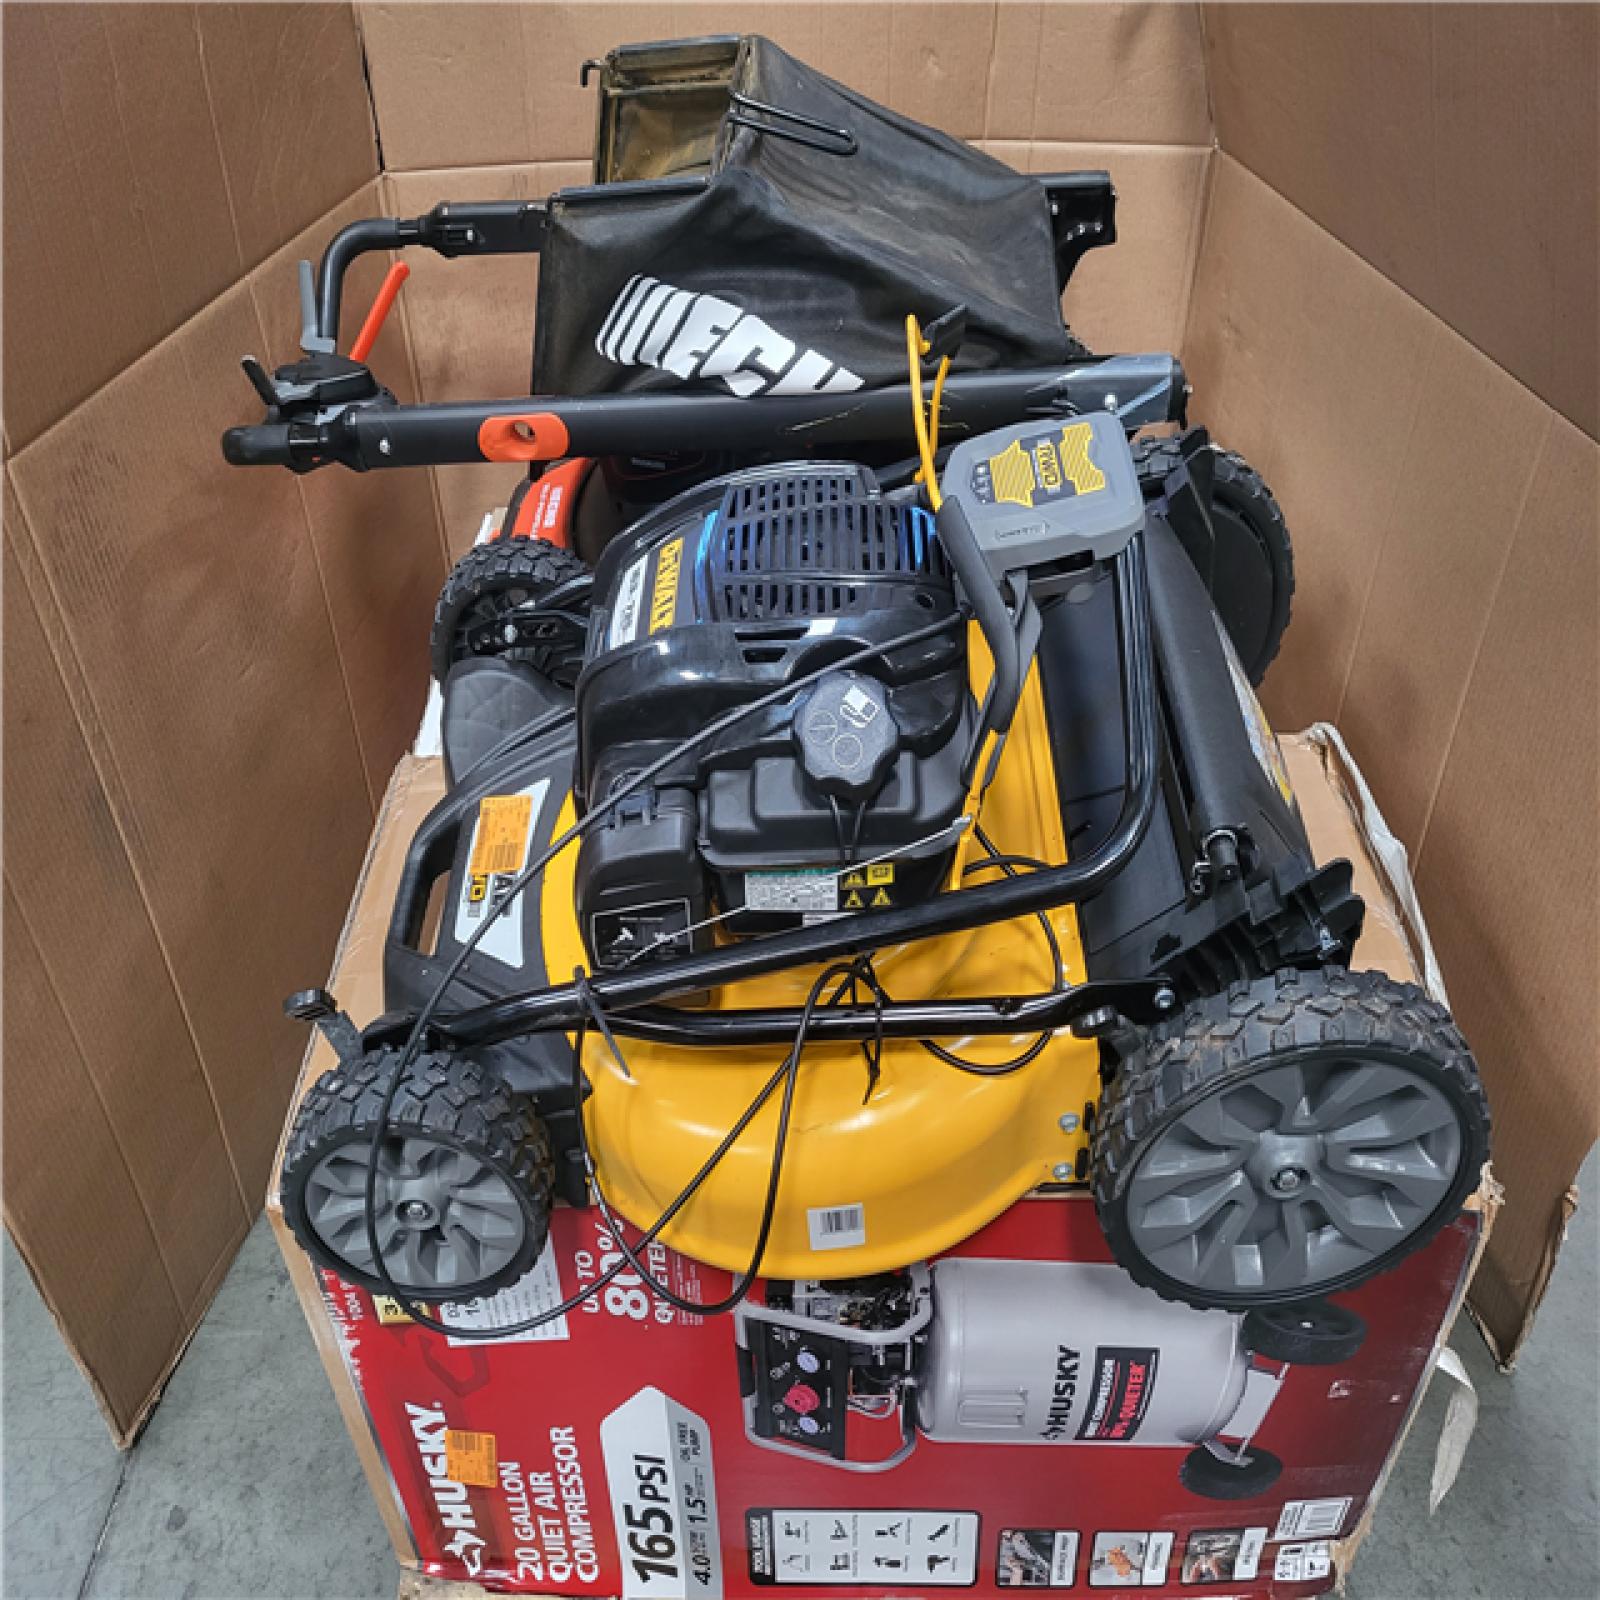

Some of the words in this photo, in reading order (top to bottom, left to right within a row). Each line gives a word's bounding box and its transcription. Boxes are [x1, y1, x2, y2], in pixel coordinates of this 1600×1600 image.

[574, 1250, 595, 1279] TO
[1046, 1344, 1080, 1426] HUSKY
[497, 1461, 537, 1541] GALLON
[528, 1471, 559, 1511] AIR
[550, 1425, 599, 1584] COMPRESSOR
[684, 1497, 708, 1524] 1.5
[514, 1545, 544, 1582] 20
[537, 1514, 574, 1583] QUIET
[690, 1554, 711, 1586] 4.0
